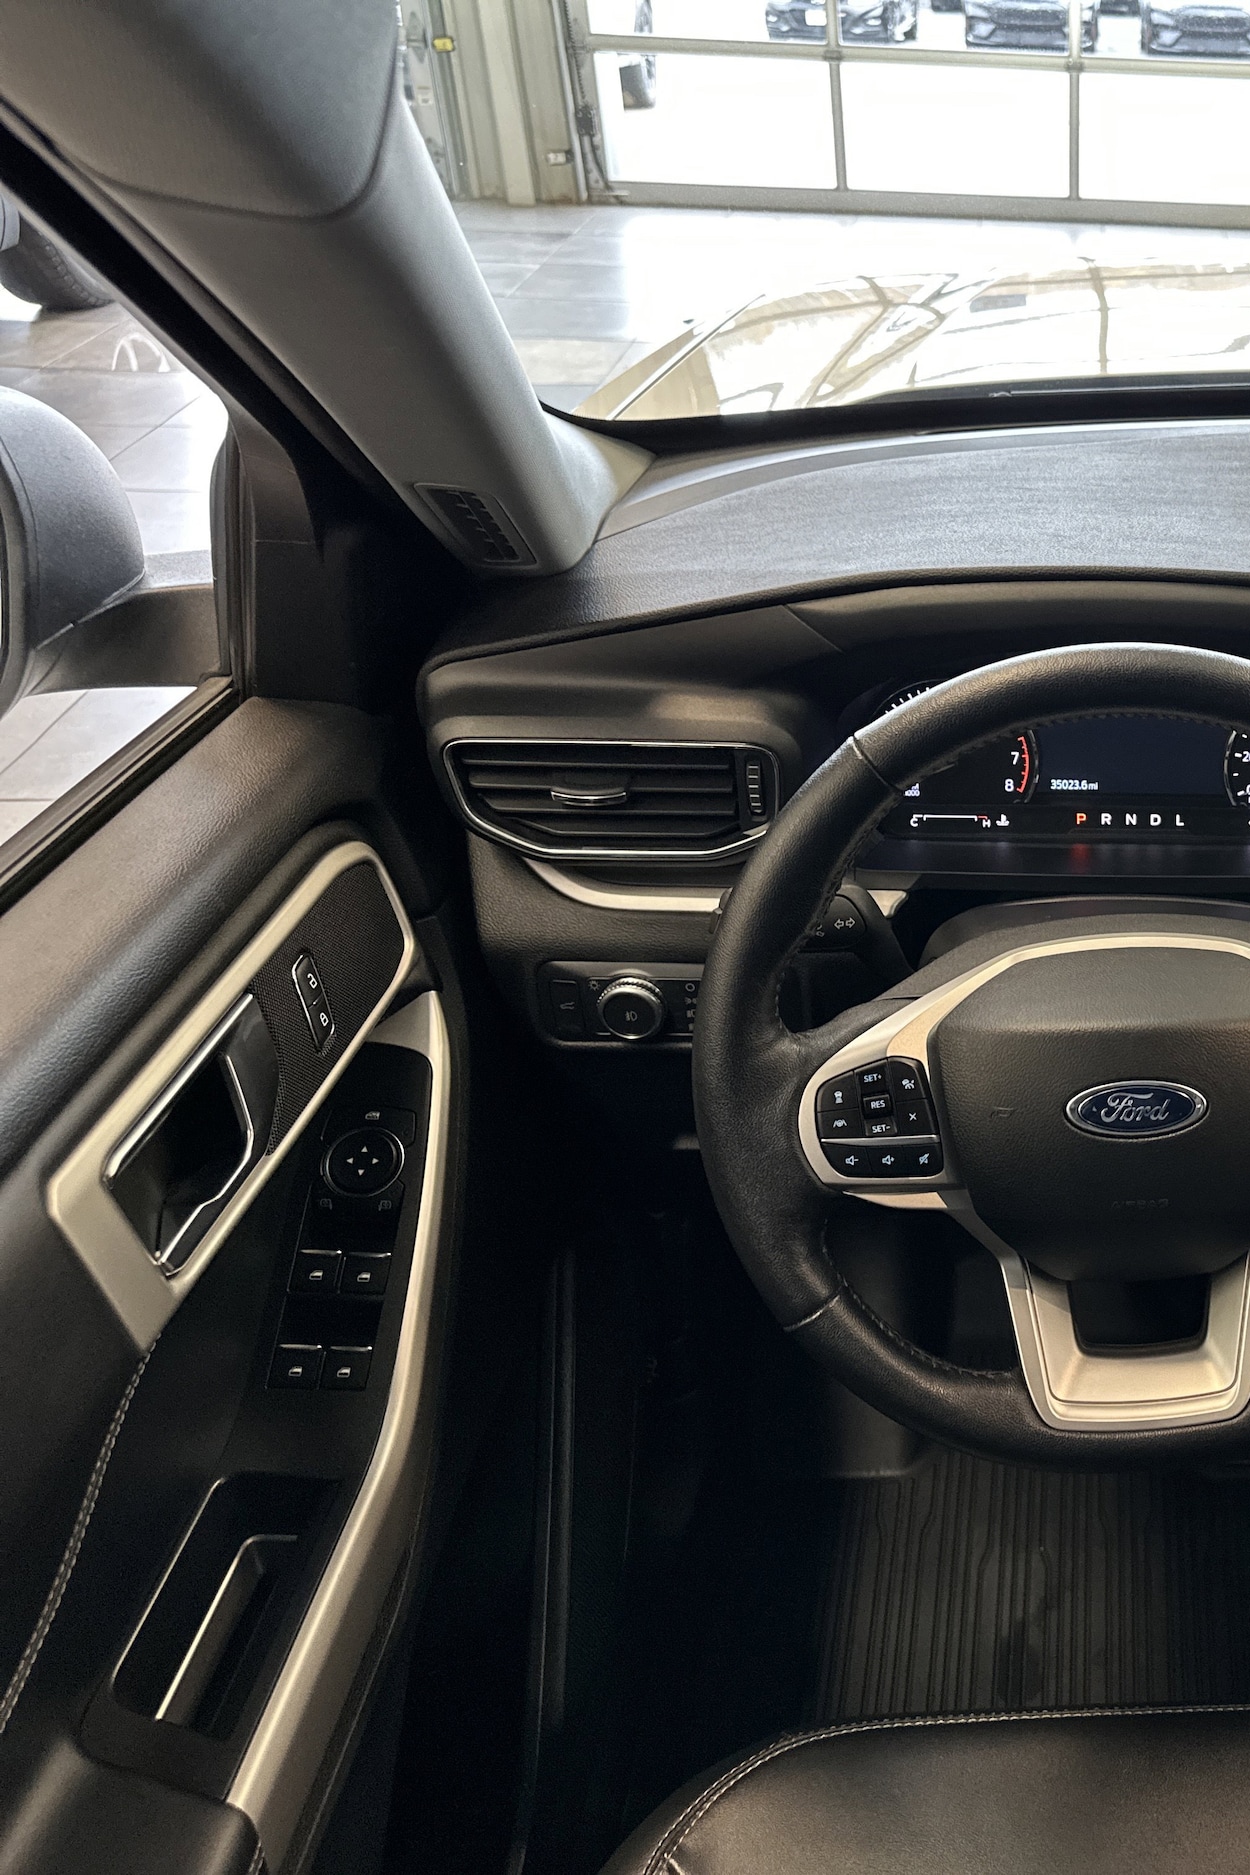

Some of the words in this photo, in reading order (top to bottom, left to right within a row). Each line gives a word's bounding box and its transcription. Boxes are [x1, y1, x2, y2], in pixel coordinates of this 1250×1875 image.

[1010, 751, 1020, 765] 7
[1004, 779, 1014, 792] 8
[1050, 779, 1088, 790] 35023.6
[982, 818, 991, 828] H
[1076, 812, 1087, 825] P
[1101, 813, 1112, 825] R
[1125, 813, 1137, 826] N
[1150, 813, 1162, 826] D
[1175, 814, 1185, 826] L
[870, 1099, 886, 1109] RES
[1100, 1092, 1171, 1123] Ford
